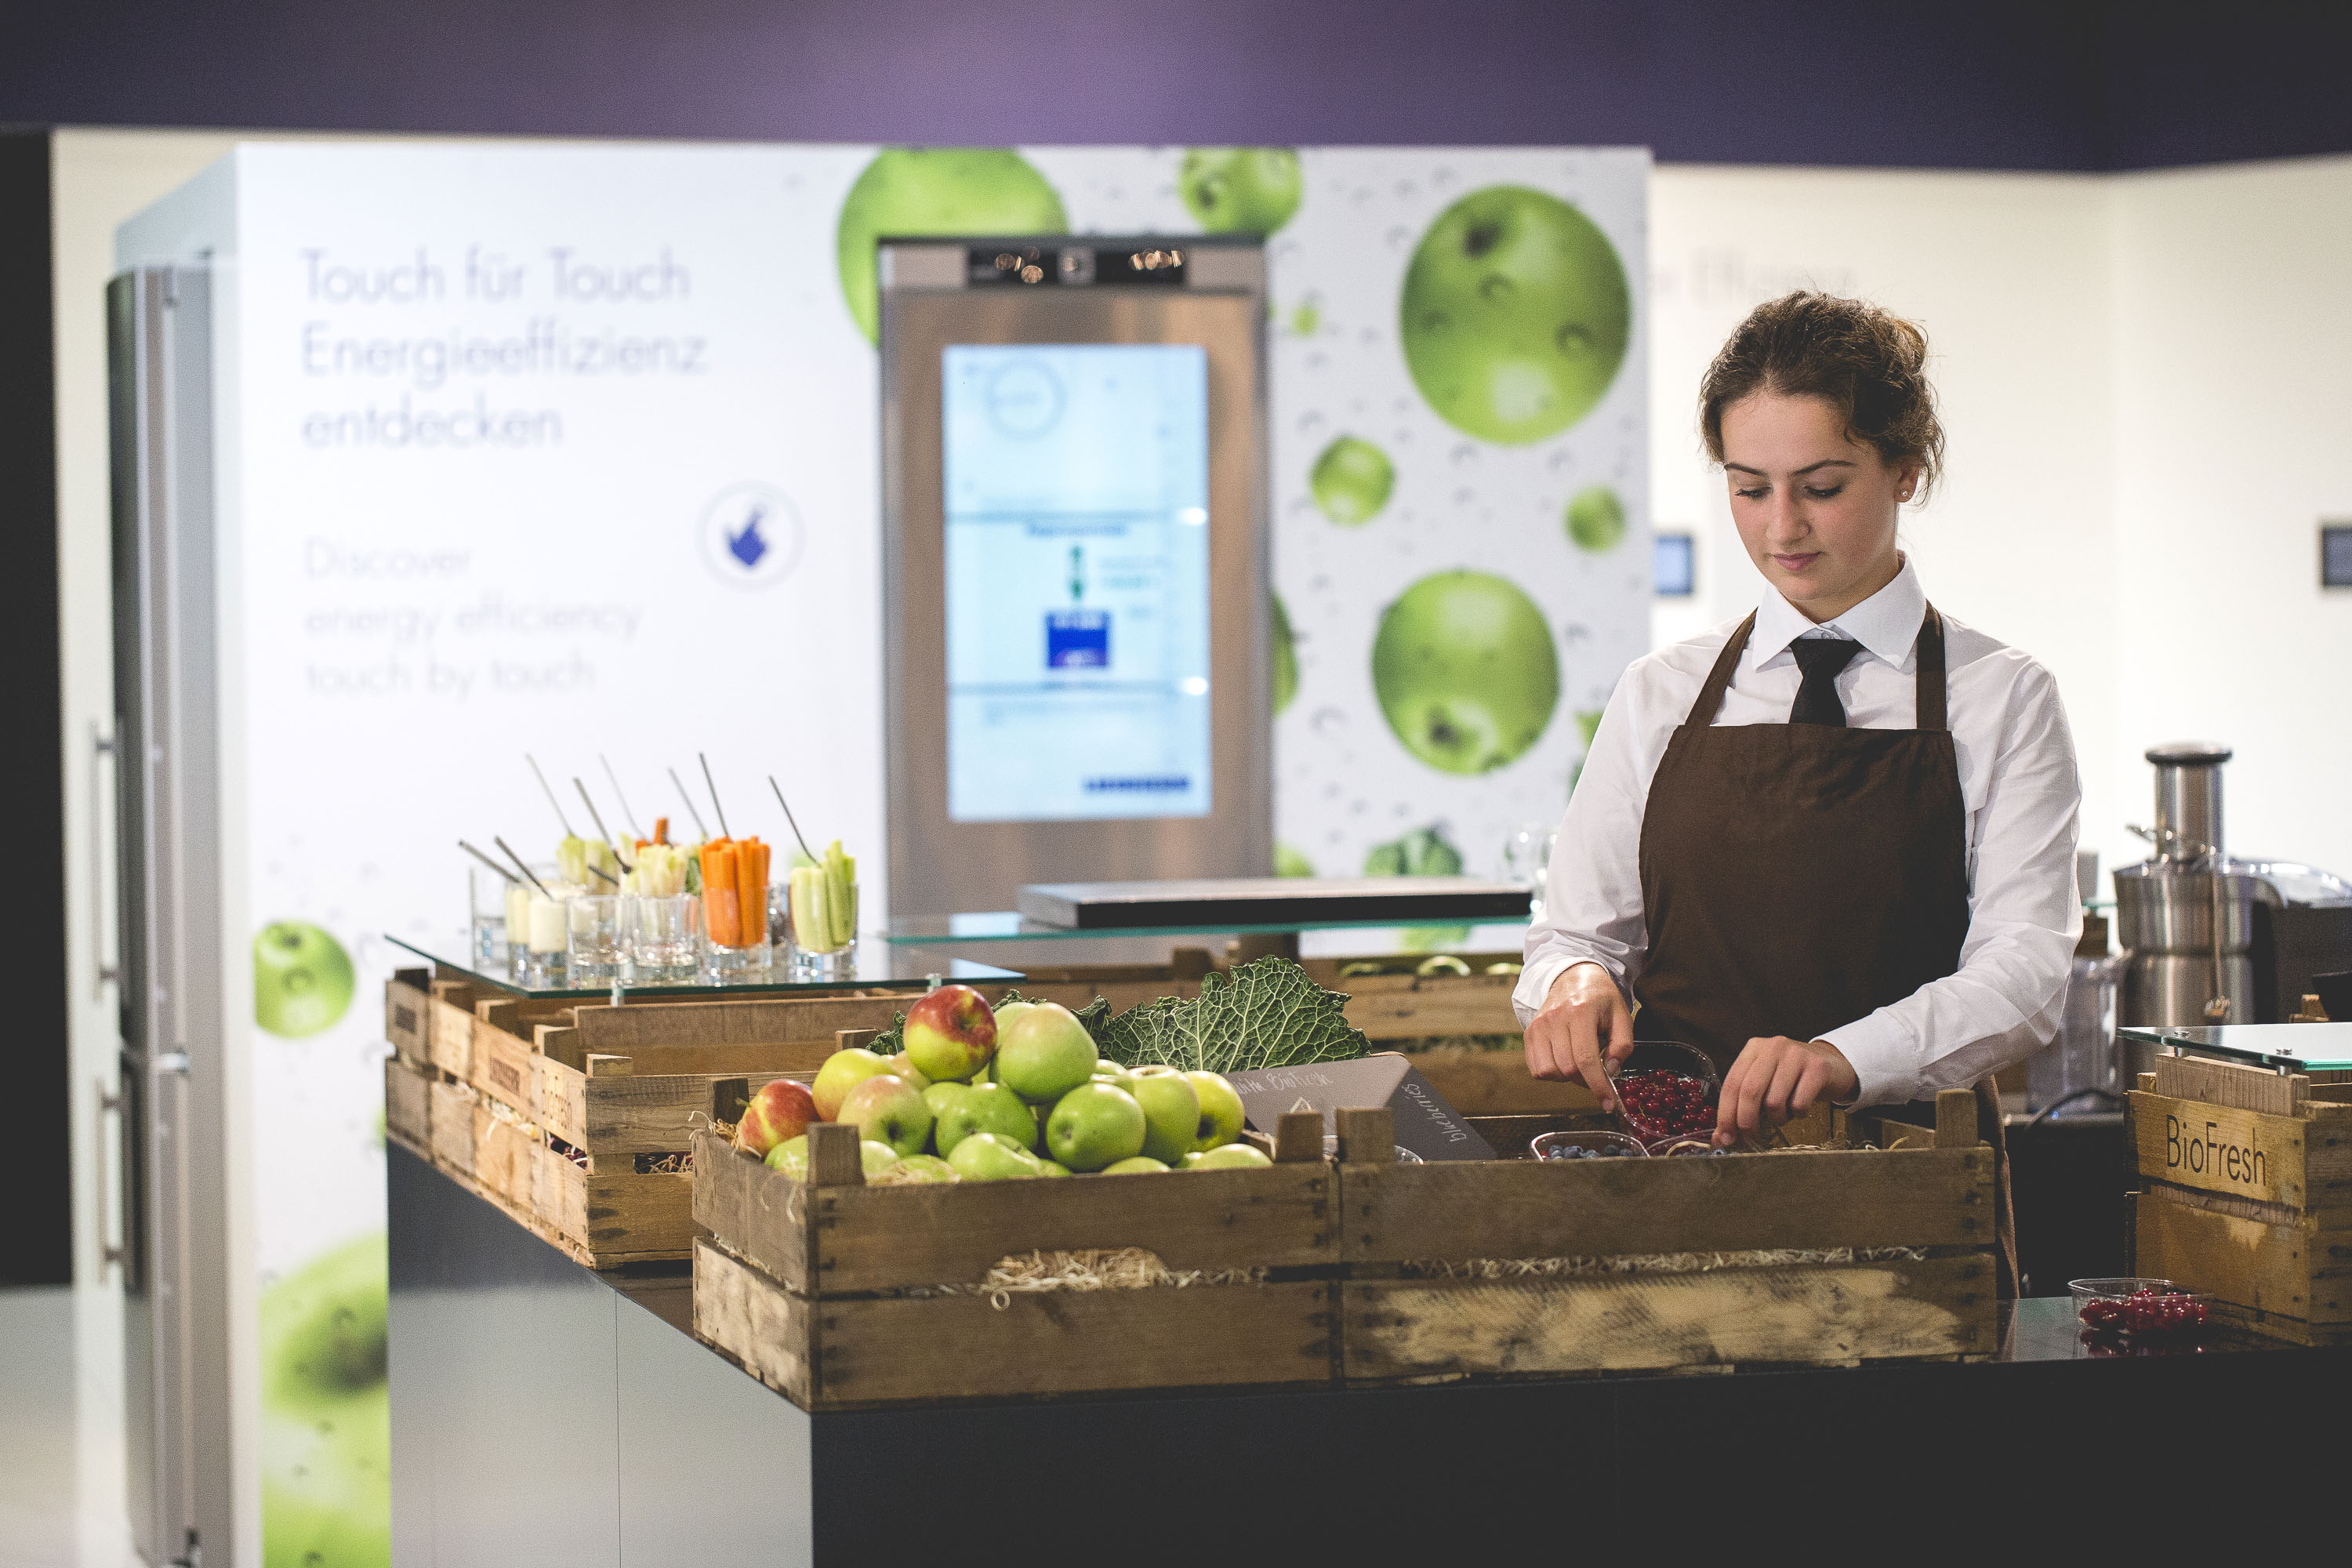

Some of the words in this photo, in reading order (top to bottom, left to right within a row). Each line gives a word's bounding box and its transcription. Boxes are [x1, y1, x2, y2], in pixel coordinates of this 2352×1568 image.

[300, 245, 445, 303] Touch
[465, 243, 526, 303] für
[546, 245, 691, 303] Touch
[301, 315, 709, 390] Energieeffizienz
[301, 391, 562, 449] entdecken
[303, 535, 470, 580] Discover
[304, 604, 441, 648] energy
[456, 589, 643, 647] efficiency
[305, 652, 412, 696] touch
[428, 651, 475, 706] by
[492, 646, 595, 696] touch
[2165, 1114, 2267, 1186] BioFresh
